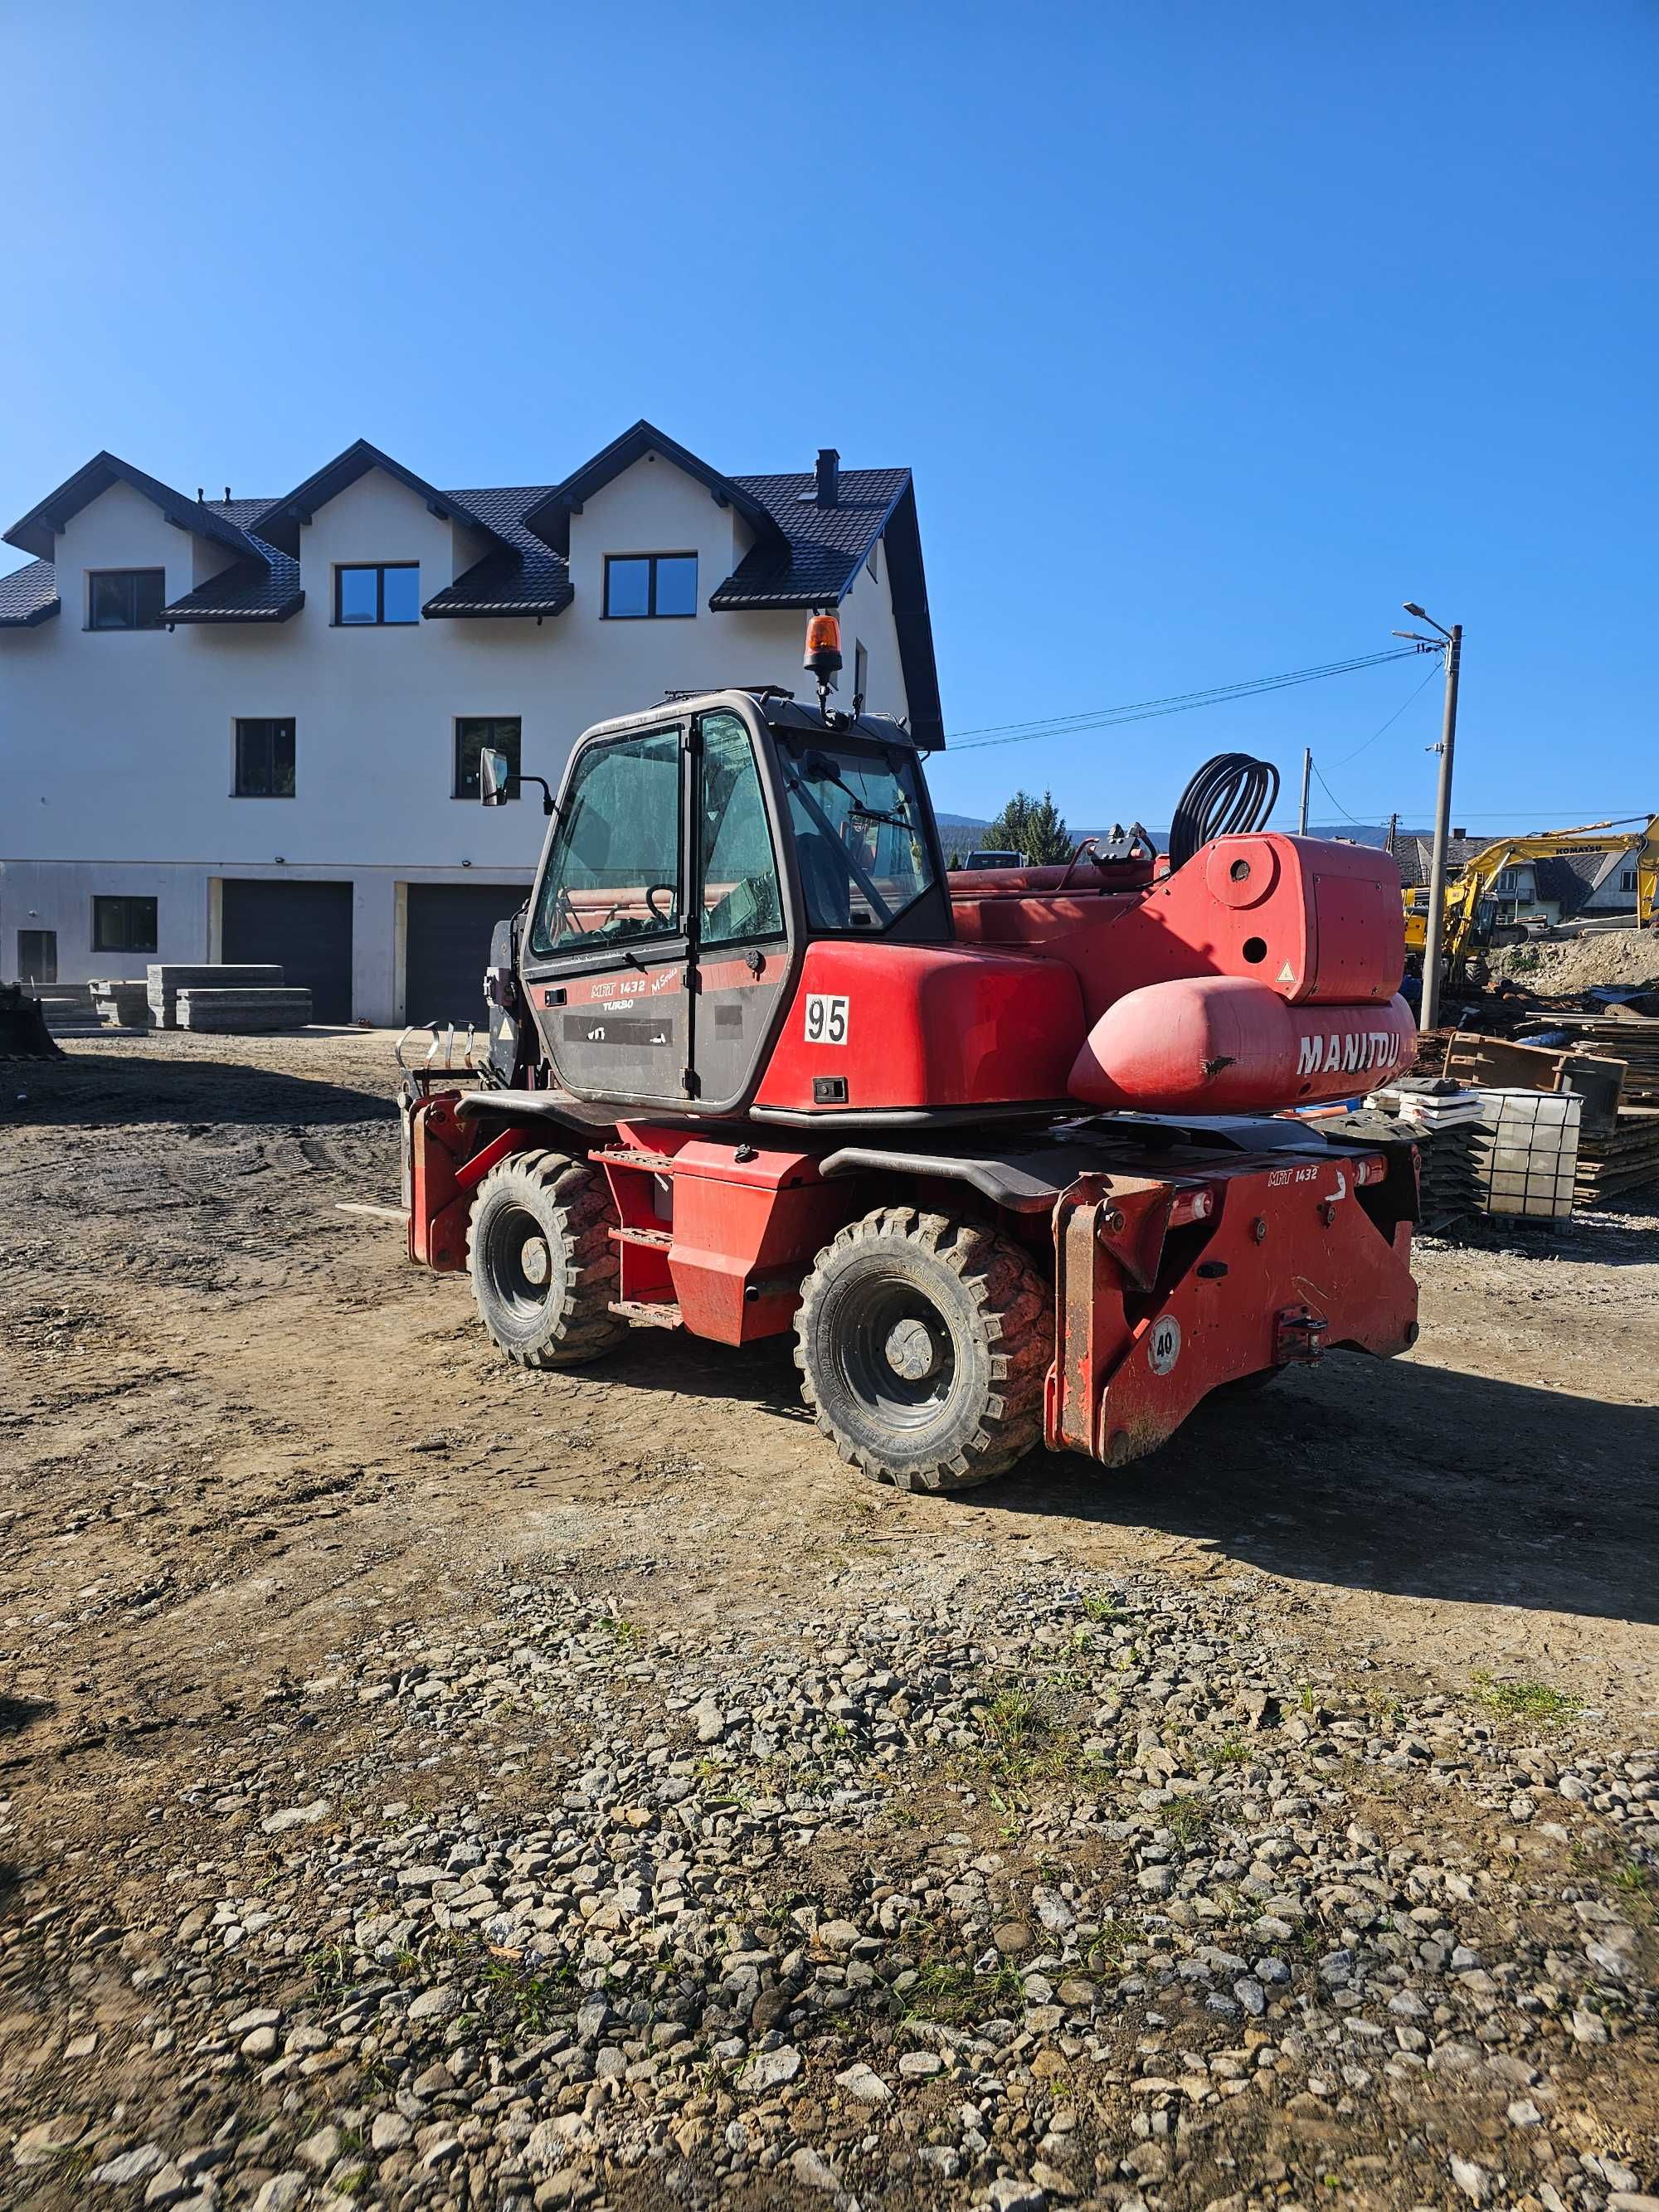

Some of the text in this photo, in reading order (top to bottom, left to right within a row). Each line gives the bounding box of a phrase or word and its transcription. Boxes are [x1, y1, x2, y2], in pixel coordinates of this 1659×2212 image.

[1555, 845, 1602, 855] KOMATSU
[591, 982, 615, 998] MRT
[620, 980, 645, 994] 1432
[603, 999, 634, 1010] TURBO
[808, 998, 845, 1042] 95
[1296, 1032, 1399, 1075] MANITOU
[1267, 1168, 1318, 1187] MRT 1432
[1156, 1331, 1173, 1357] 40
